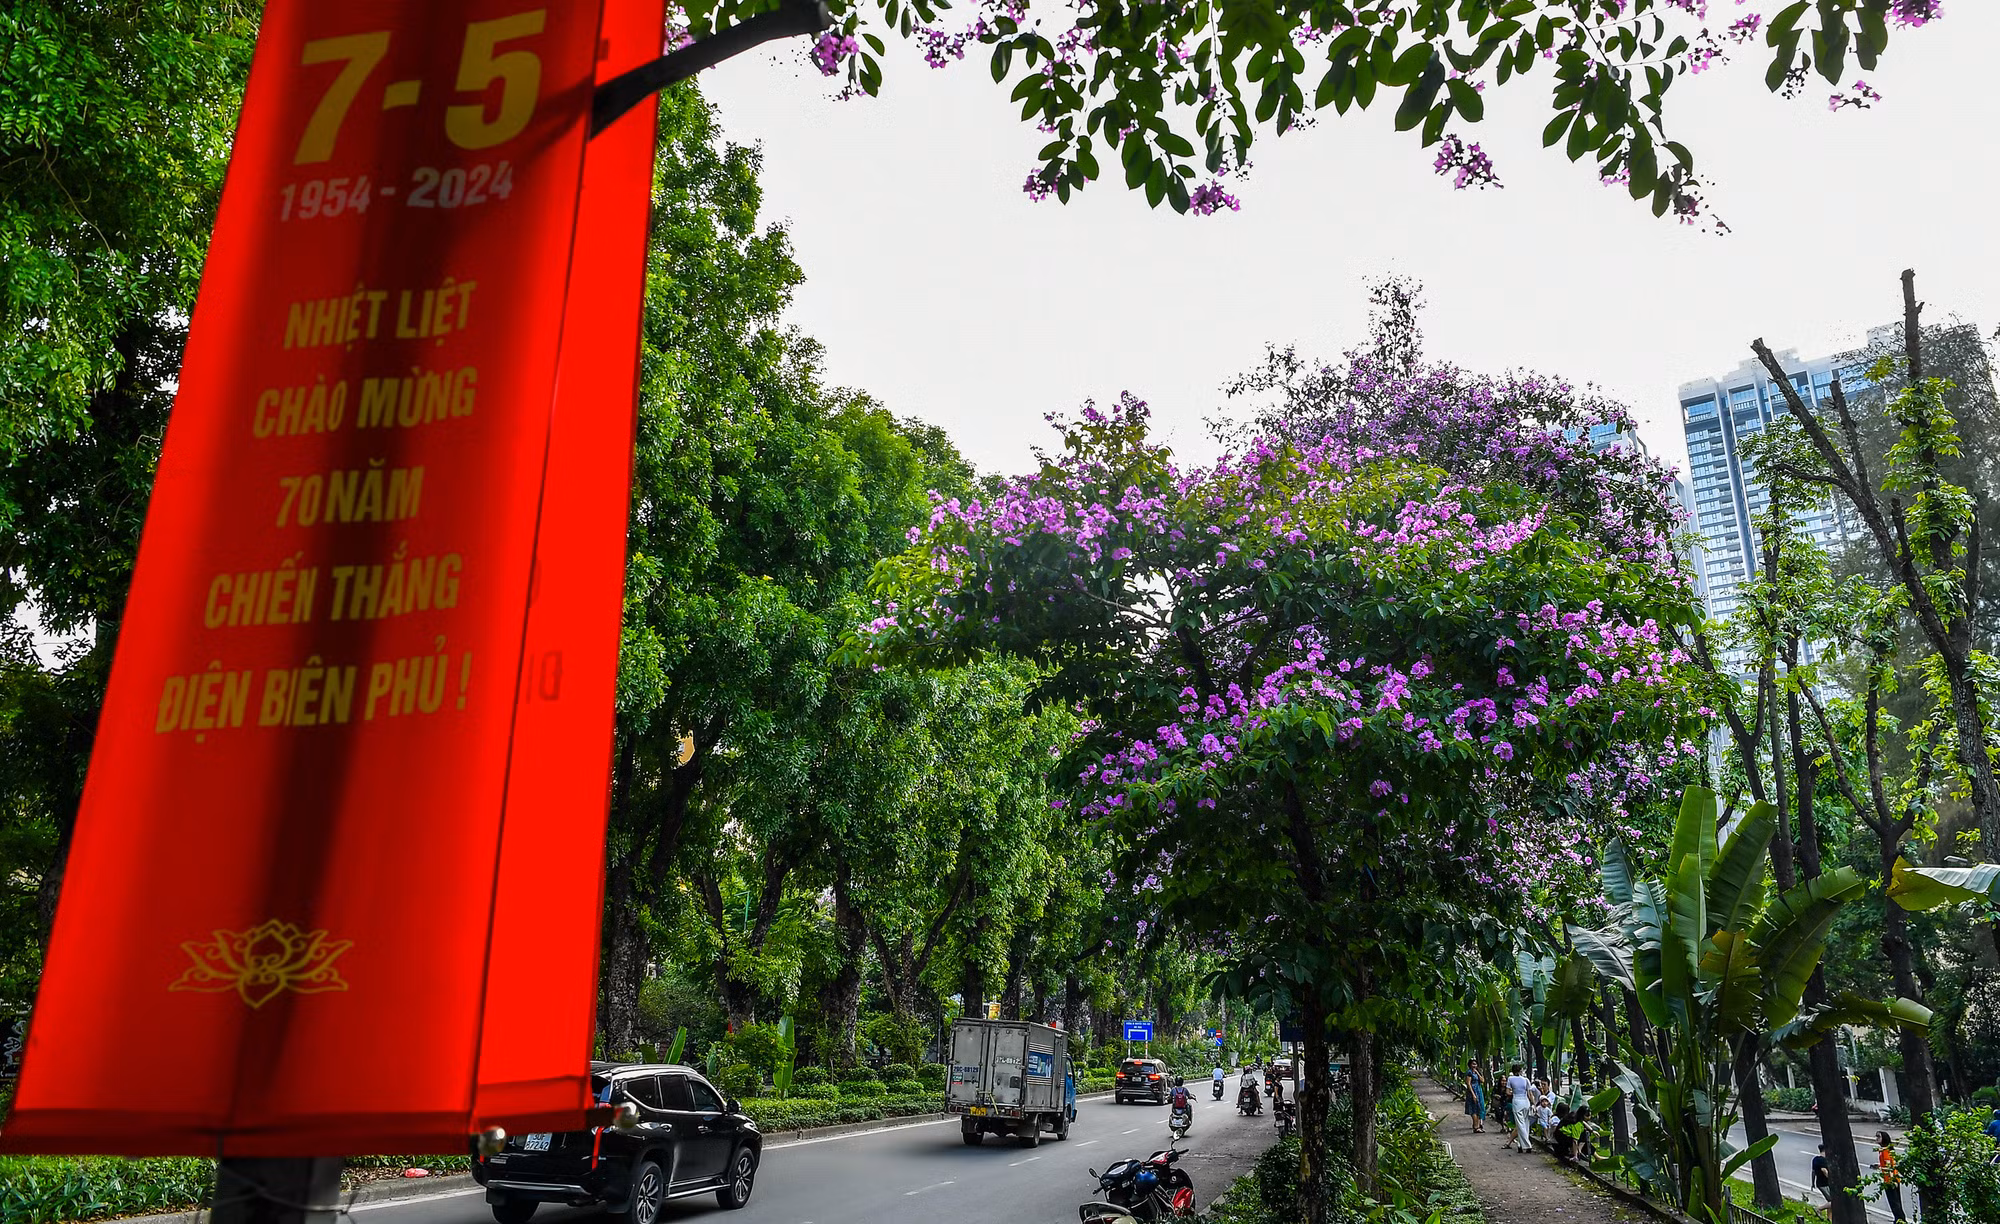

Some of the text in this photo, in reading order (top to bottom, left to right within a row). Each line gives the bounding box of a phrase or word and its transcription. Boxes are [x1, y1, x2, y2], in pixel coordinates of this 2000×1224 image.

[280, 176, 371, 222] 1954
[406, 161, 513, 209] 2024
[284, 276, 477, 351] NHIỆT LIỆT
[253, 366, 477, 438] CHÀO MỪNG
[204, 540, 463, 629] CHIẾN THẮNG
[156, 659, 252, 744] ĐIỆN
[258, 656, 357, 727] BIÊN
